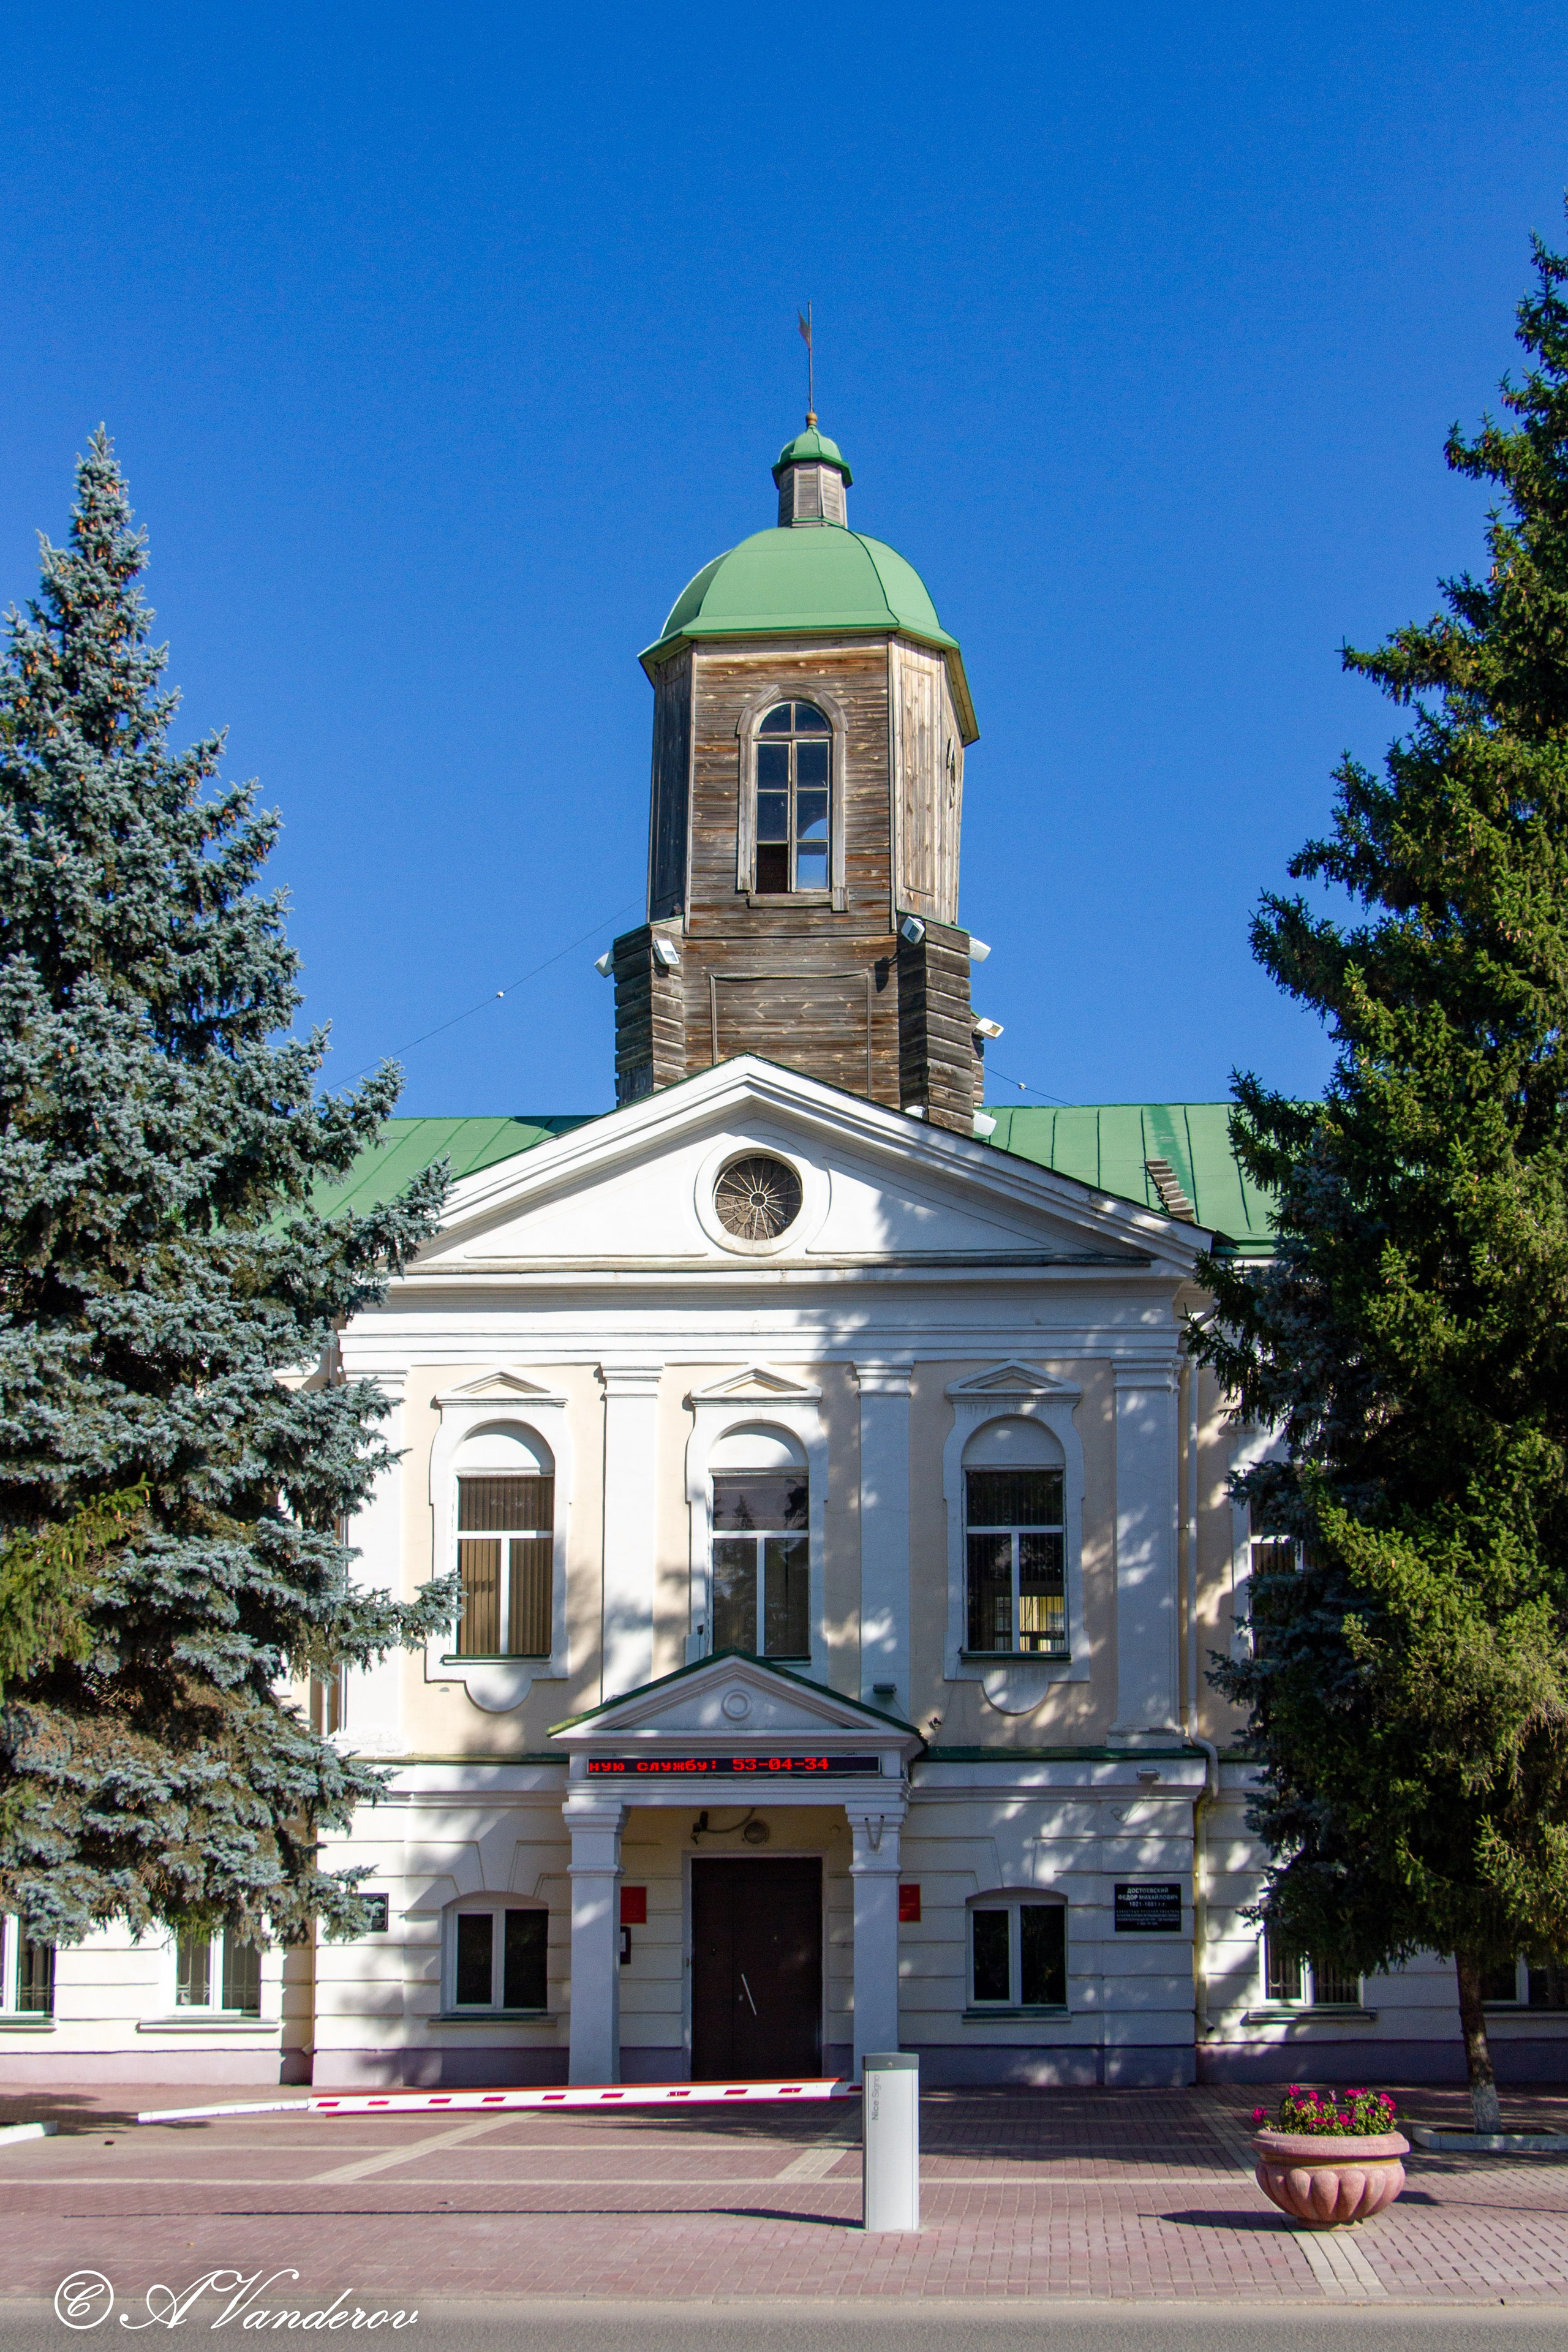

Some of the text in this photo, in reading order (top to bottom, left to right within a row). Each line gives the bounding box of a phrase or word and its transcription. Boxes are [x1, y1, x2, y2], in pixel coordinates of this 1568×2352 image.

[589, 1757, 829, 1771] ную службу: 53-04-34
[872, 2075, 881, 2098] Signo
